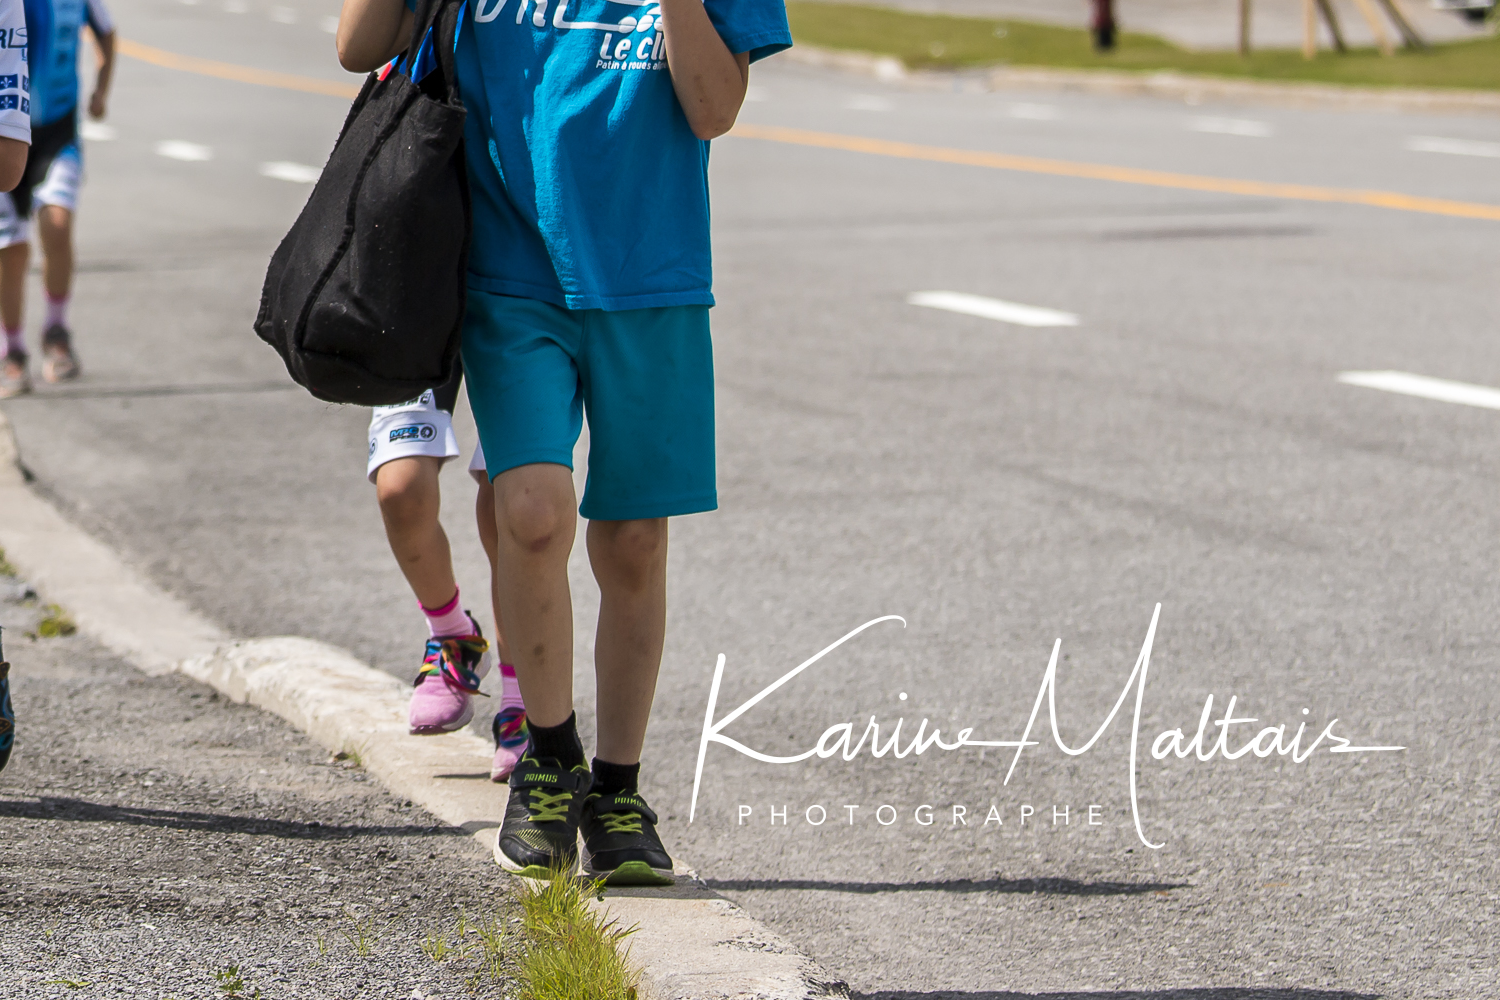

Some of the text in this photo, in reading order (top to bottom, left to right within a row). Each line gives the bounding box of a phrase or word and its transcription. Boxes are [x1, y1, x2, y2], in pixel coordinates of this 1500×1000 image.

[599, 32, 632, 60] Le
[596, 59, 620, 70] Patin
[628, 61, 652, 71] roues
[390, 427, 418, 438] MPC
[524, 773, 558, 782] PRIMUS
